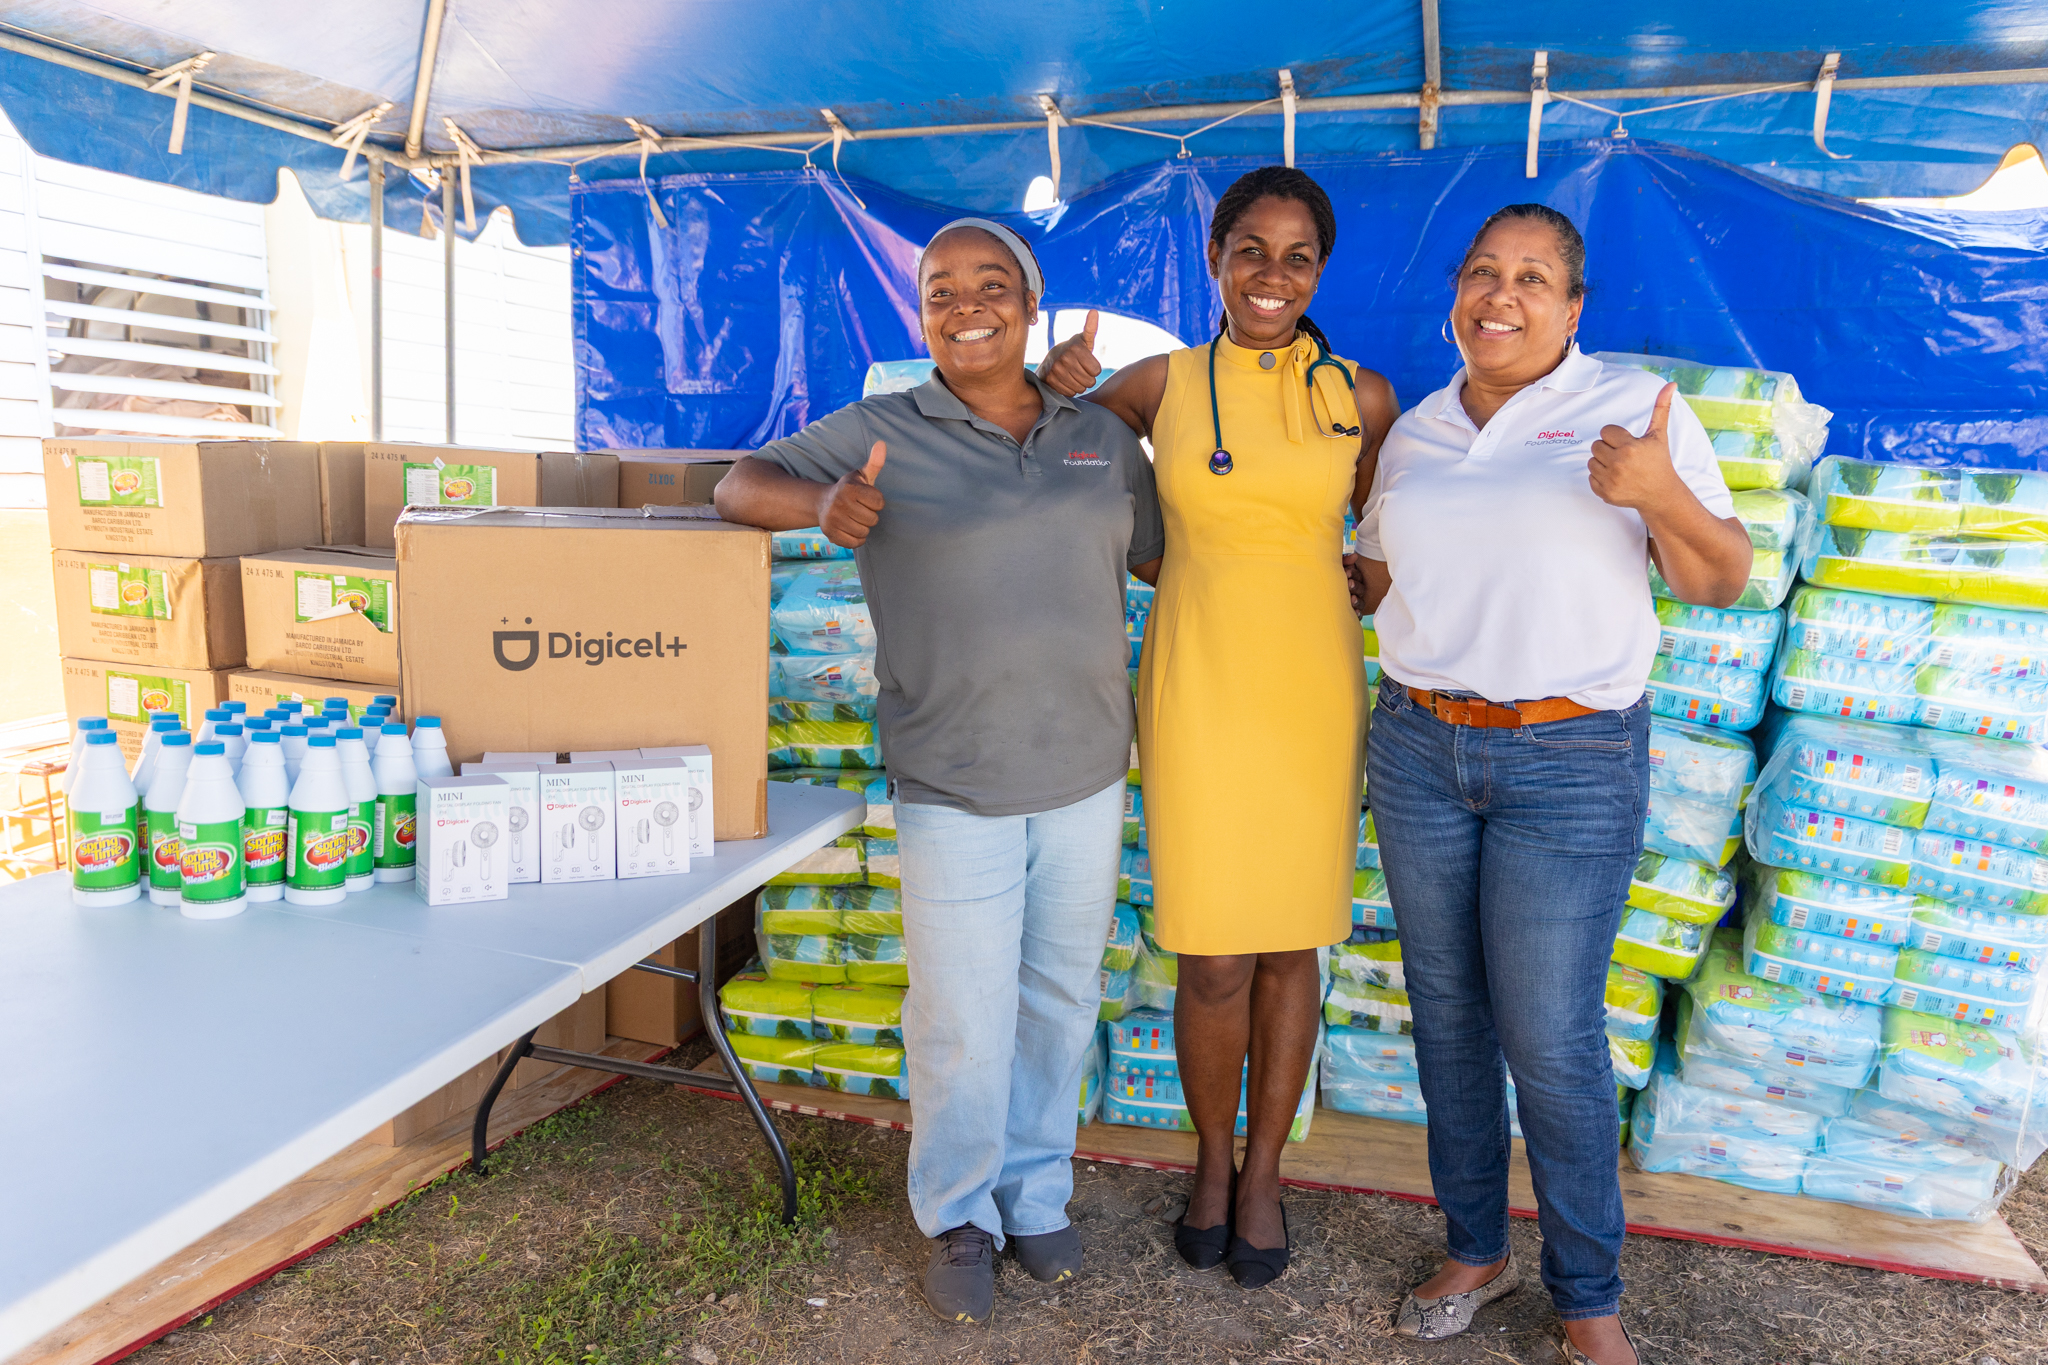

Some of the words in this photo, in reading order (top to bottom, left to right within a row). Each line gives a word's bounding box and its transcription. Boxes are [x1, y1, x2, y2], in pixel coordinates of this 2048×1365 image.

[1537, 430, 1575, 440] Digicel
[1524, 438, 1583, 446] Foundation
[371, 452, 378, 460] 24
[400, 454, 408, 462] ML
[83, 508, 117, 517] MANUFACTURED
[107, 518, 132, 526] CARIBBEAN
[109, 526, 136, 534] INDUSTRIAL
[136, 528, 154, 536] ESTATE
[105, 534, 128, 542] KINGSTON
[65, 560, 68, 568] X
[246, 568, 254, 576] 24
[256, 568, 260, 576] X
[262, 569, 274, 578] 475
[276, 570, 284, 578] ML
[286, 632, 325, 642] MANUFACTURED
[332, 638, 356, 646] JAMAICA
[142, 642, 159, 650] ESTATE
[312, 643, 340, 652] CARIBBEAN
[342, 646, 353, 654] LTD.
[548, 631, 688, 666] Digicel+
[314, 652, 344, 662] INDUSTRIAL
[346, 656, 364, 664] ESTATE
[310, 660, 335, 668] KINGSTON
[80, 668, 90, 676] 475
[92, 670, 99, 678] ML
[235, 684, 243, 693] 24
[244, 685, 249, 693] X
[251, 686, 262, 694] 475
[264, 687, 273, 696] ML
[546, 778, 570, 787] MINI
[622, 774, 645, 783] MINI
[438, 792, 463, 801] MINI
[80, 836, 119, 856] Spring
[246, 832, 284, 852] Spring
[314, 834, 347, 856] Spring
[93, 846, 122, 861] Time
[160, 841, 180, 857] Spr
[262, 841, 286, 857] Time
[181, 849, 218, 866] Spring
[250, 854, 280, 869] Bleach
[84, 859, 116, 874] Bleach
[193, 858, 222, 874] Time
[318, 857, 344, 872] Bleach
[186, 872, 214, 884] Bleach
